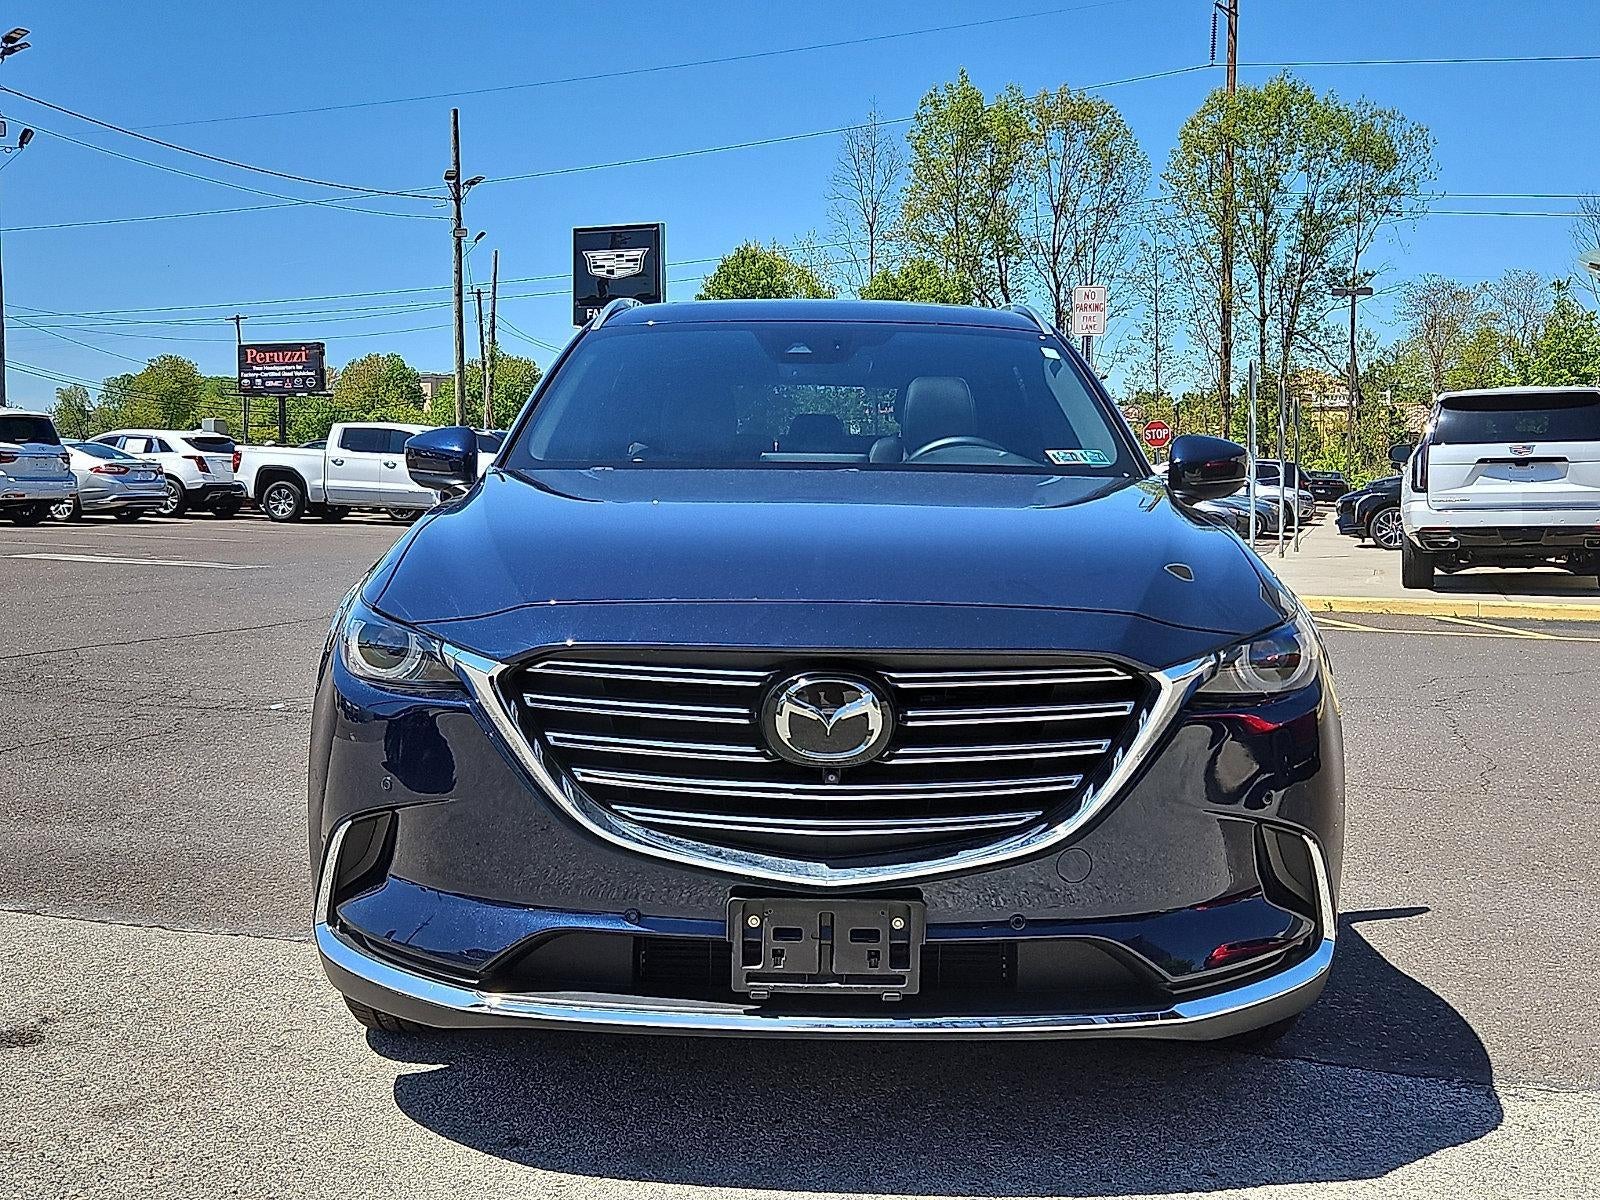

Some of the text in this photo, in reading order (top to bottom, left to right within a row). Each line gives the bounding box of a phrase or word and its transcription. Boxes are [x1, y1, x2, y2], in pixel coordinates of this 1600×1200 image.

[1084, 291, 1096, 301] NO
[1075, 303, 1104, 312] PARKING
[1082, 315, 1097, 323] FIRE
[245, 346, 308, 364] Peruzzi
[1145, 428, 1169, 441] STOP
